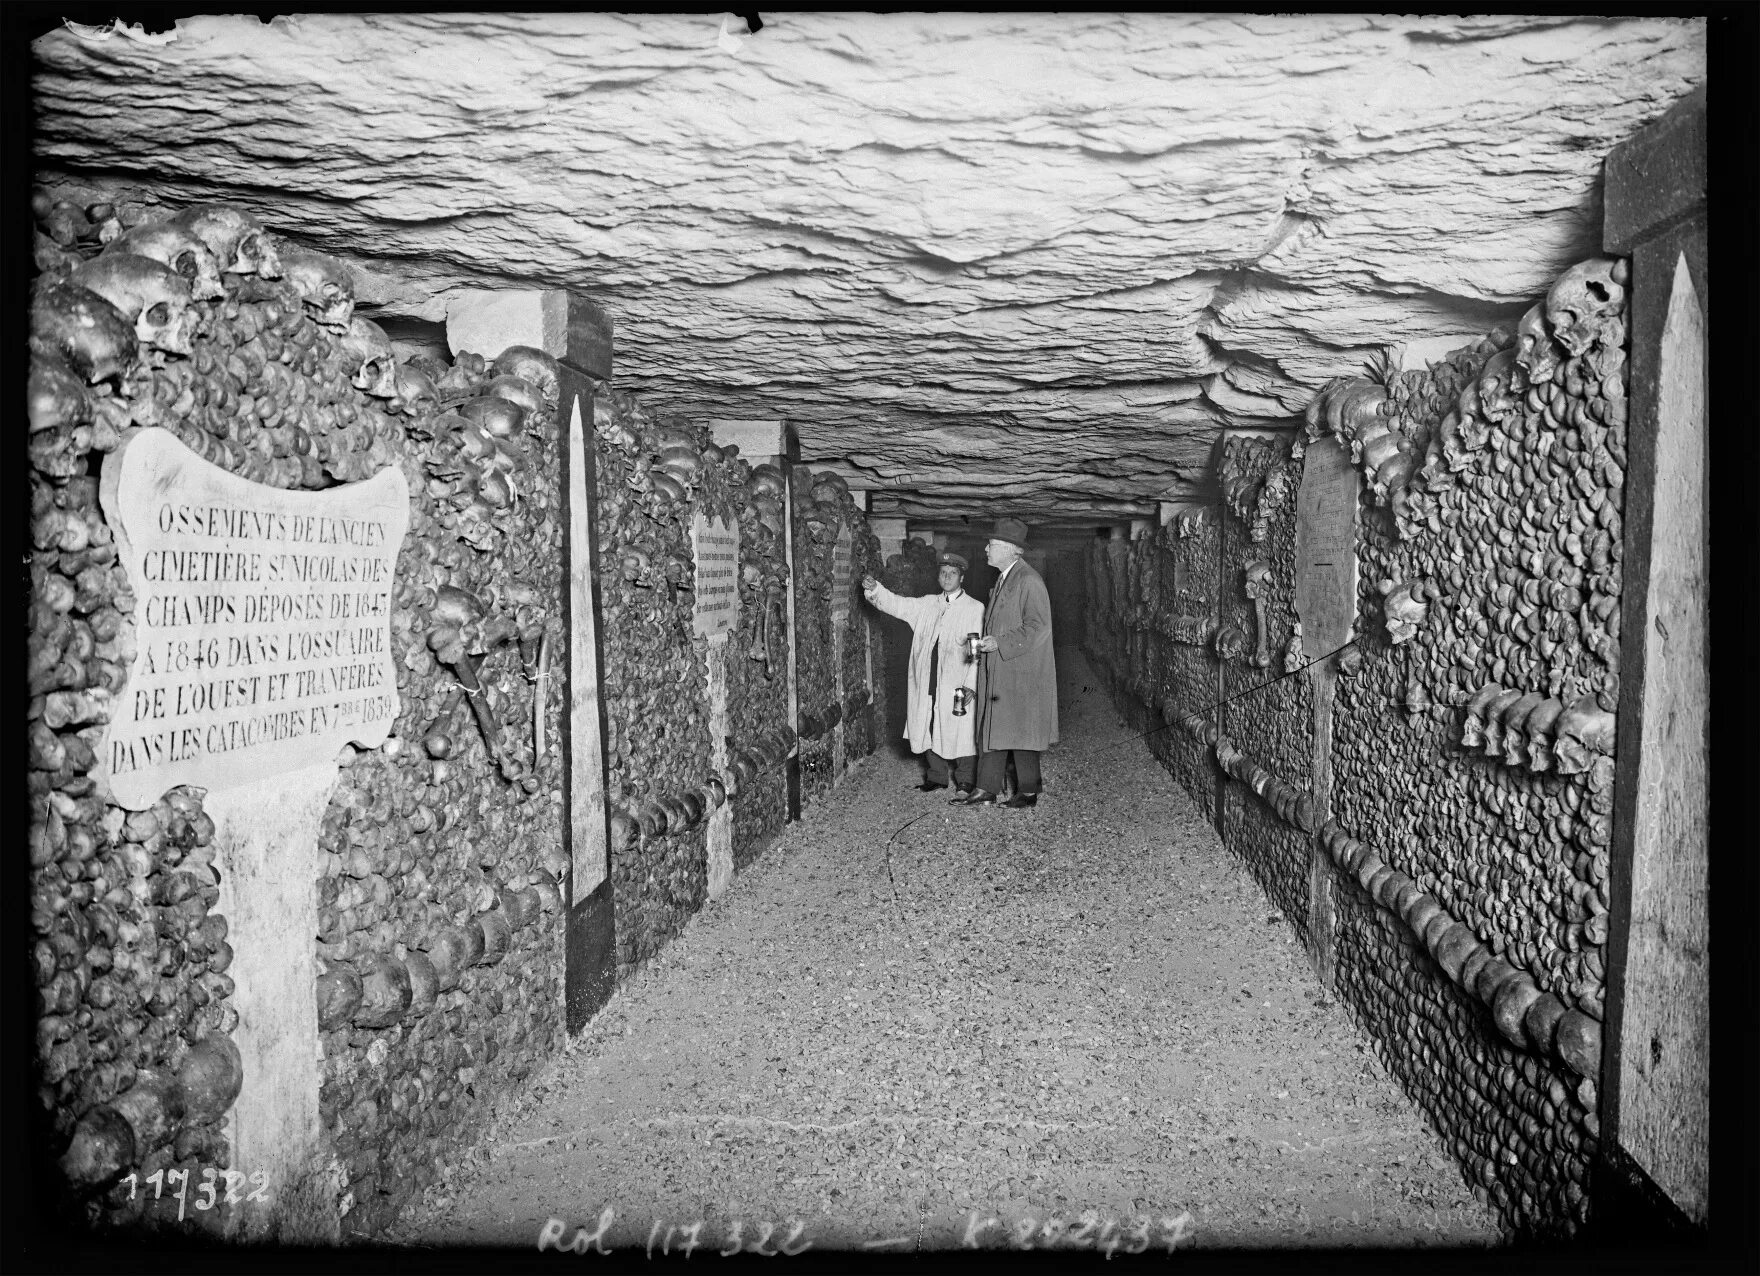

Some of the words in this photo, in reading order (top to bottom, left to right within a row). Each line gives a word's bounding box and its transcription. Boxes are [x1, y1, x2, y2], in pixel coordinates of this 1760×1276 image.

[159, 503, 287, 541] OSSEMENTS
[292, 515, 315, 543] DE
[319, 517, 386, 547] L'ANCIEN
[143, 543, 261, 582] CIMETIÈRE
[291, 554, 358, 582] NICOLAS
[361, 557, 389, 582] DES
[146, 595, 236, 628] CHAMPS
[244, 585, 324, 623] DÉPOSÉS
[330, 592, 351, 619] DE
[166, 637, 220, 673] 1846
[226, 633, 278, 667] DANS
[287, 627, 384, 662] L'OSSUAIRE
[134, 688, 166, 721] DE
[176, 676, 260, 716] L'OUEST
[267, 673, 289, 702] ET
[296, 656, 384, 698] TRANFÉRÉS
[112, 734, 164, 775] DANS
[170, 727, 201, 762] LES
[206, 709, 305, 754] CATACOMBES
[310, 706, 329, 735] EN
